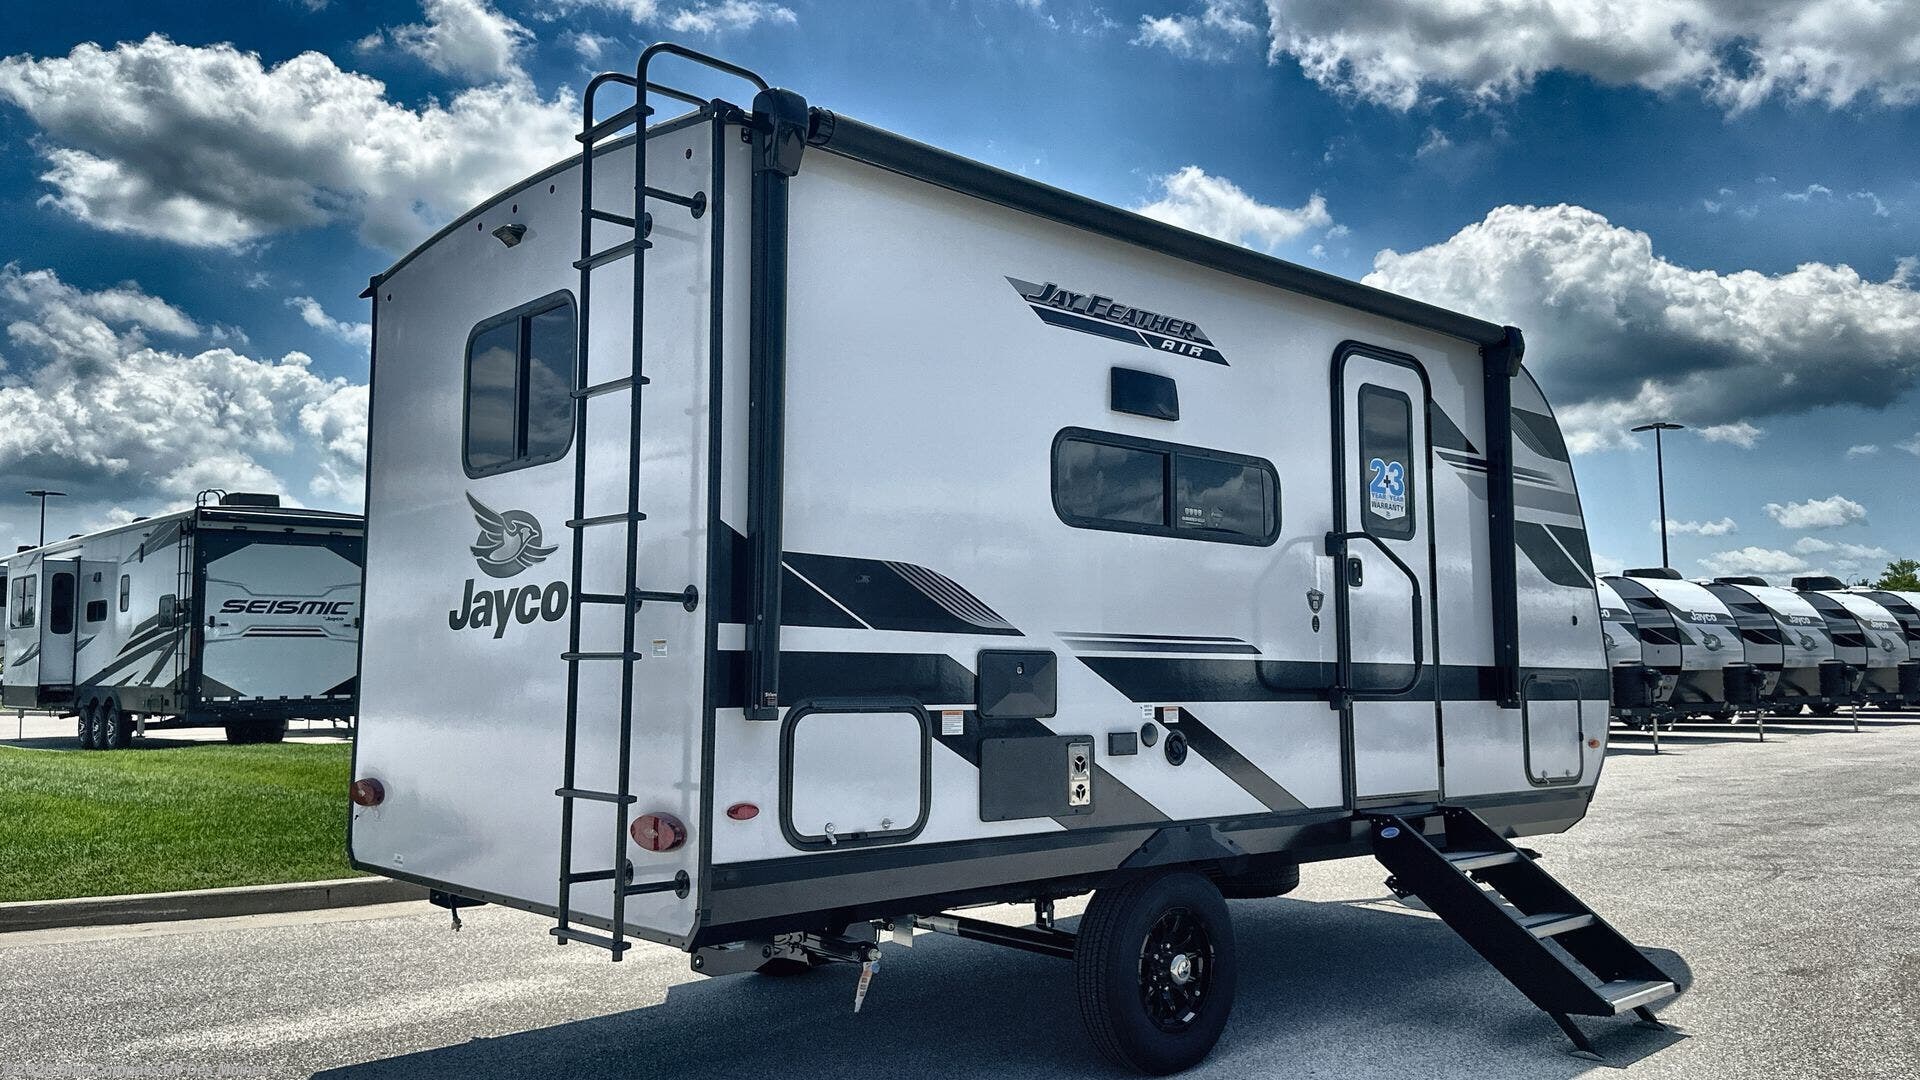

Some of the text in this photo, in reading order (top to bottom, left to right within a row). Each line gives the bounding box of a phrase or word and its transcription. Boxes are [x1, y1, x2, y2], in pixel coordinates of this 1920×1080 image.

[1026, 281, 1197, 340] JAY FEATHER
[1161, 339, 1203, 357] AIR
[1371, 500, 1404, 512] WARRANTY
[219, 599, 355, 615] SEISMIC
[449, 578, 569, 639] Jayco
[1690, 609, 1717, 624] Jayco
[1788, 613, 1811, 626] Jayco
